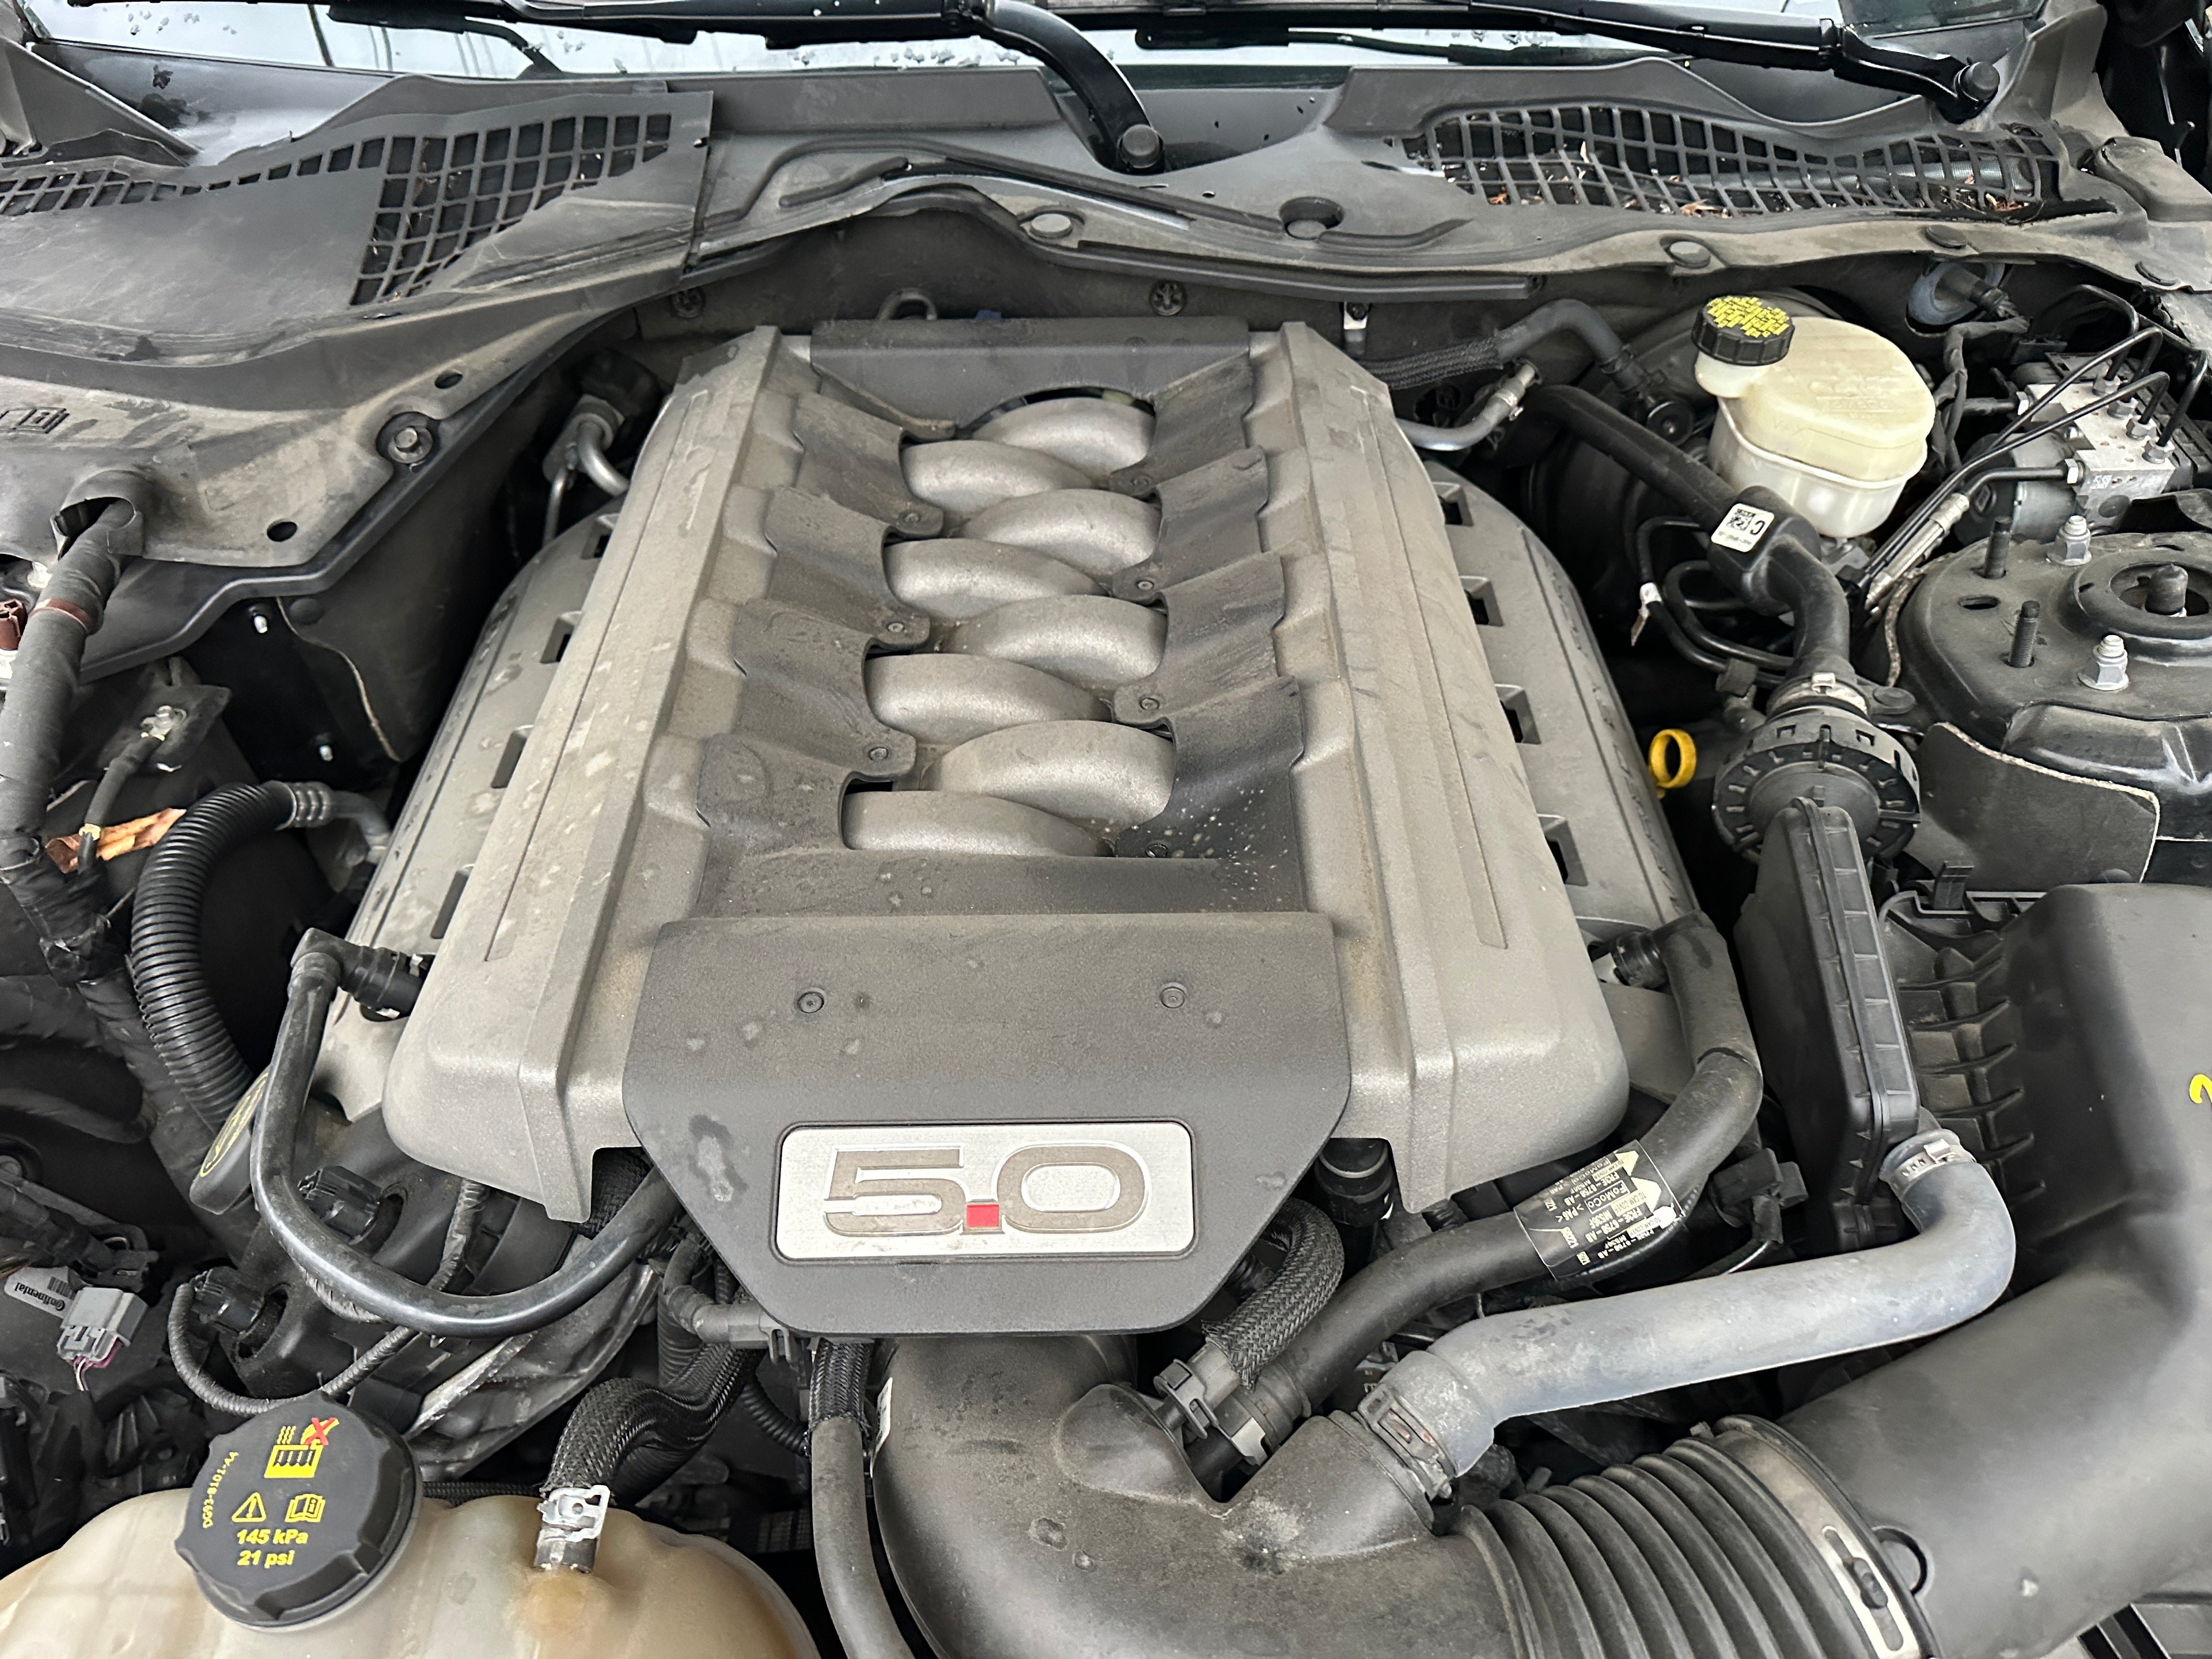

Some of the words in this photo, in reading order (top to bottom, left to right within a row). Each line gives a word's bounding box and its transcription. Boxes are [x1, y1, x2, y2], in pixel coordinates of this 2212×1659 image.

[823, 1141, 1151, 1237] 5.0
[1586, 1183, 1626, 1209] FoMoCo
[1638, 1191, 1646, 1200] TO
[1612, 1200, 1629, 1214] COVER
[1627, 1195, 1639, 1206] CAM
[14, 1282, 65, 1311] Continental
[237, 1529, 271, 1544] 145
[272, 1528, 308, 1544] kPa
[237, 1550, 262, 1566] 21
[264, 1550, 296, 1569] psi
